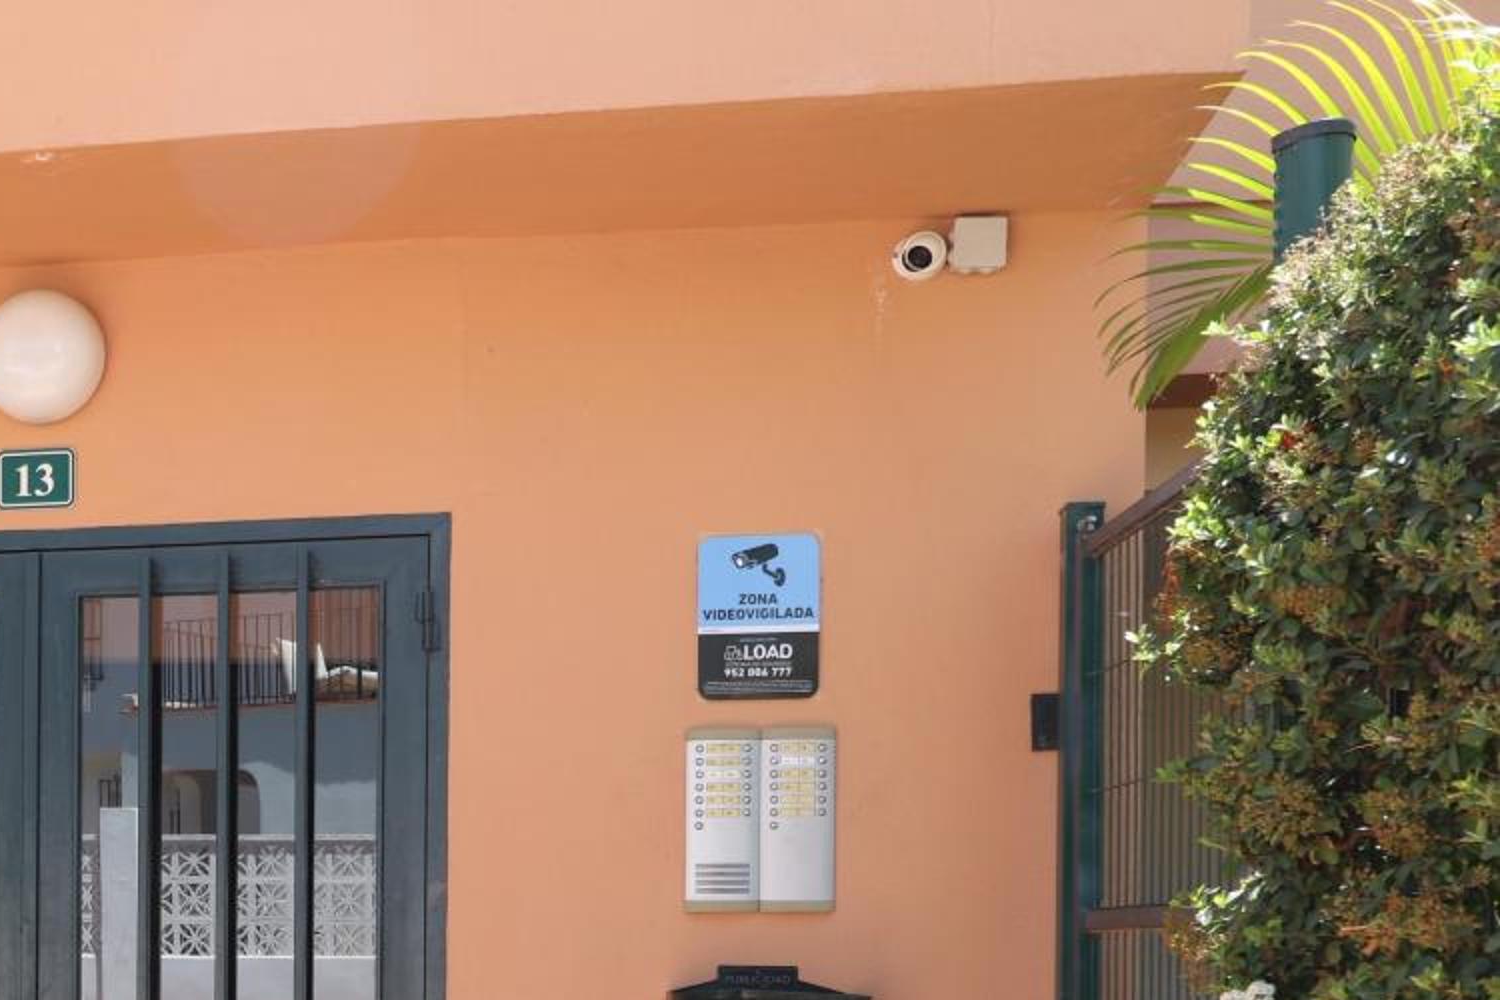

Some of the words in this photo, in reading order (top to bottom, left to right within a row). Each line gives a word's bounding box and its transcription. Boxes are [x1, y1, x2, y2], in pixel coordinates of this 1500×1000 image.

[15, 463, 55, 497] 13
[738, 593, 778, 605] ZONA
[703, 607, 814, 621] VIDEOVIGILADA
[743, 644, 793, 660] LOAD
[724, 667, 745, 678] 952
